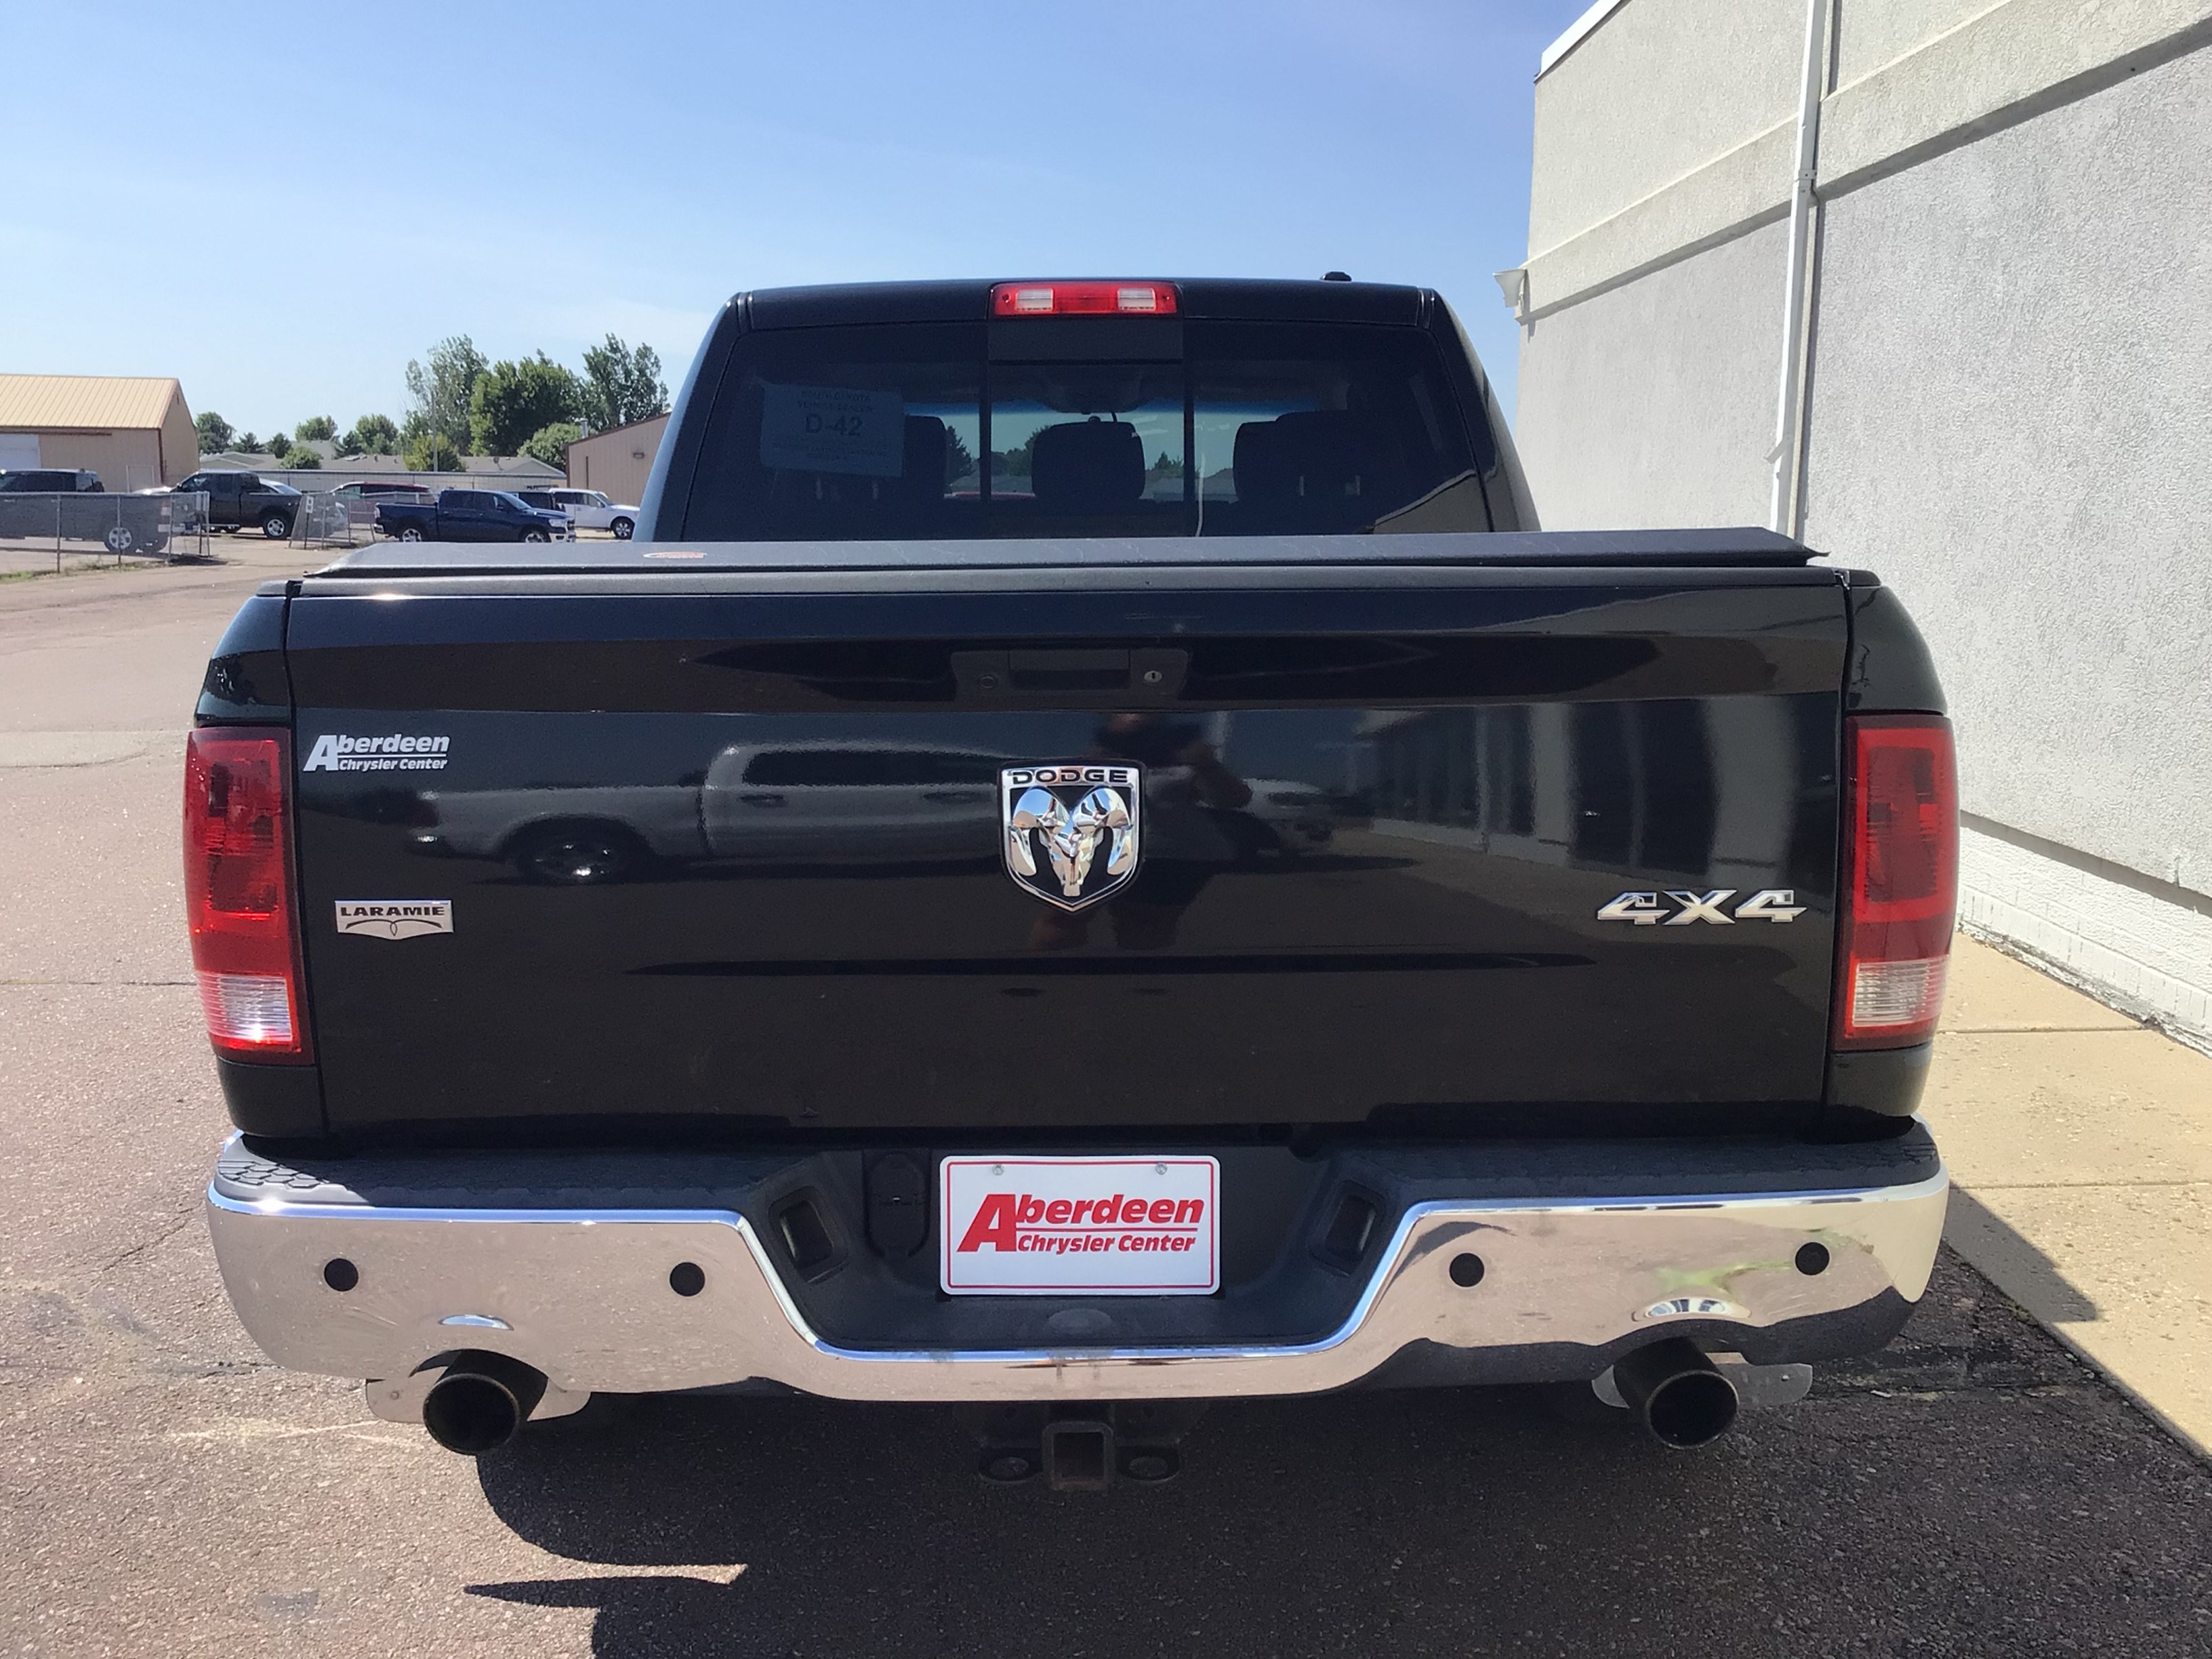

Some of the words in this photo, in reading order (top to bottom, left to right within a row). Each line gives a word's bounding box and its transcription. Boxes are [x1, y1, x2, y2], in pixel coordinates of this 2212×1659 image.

[804, 413, 863, 436] D-42
[303, 734, 450, 771] Aberdeen
[339, 758, 398, 772] Chrysler
[399, 758, 448, 771] Center
[1012, 769, 1128, 785] DODGE
[340, 906, 445, 916] LARAMIE
[956, 1193, 1205, 1253] Aberdeen
[1017, 1233, 1115, 1255] Chrysler
[1118, 1234, 1197, 1252] Center
